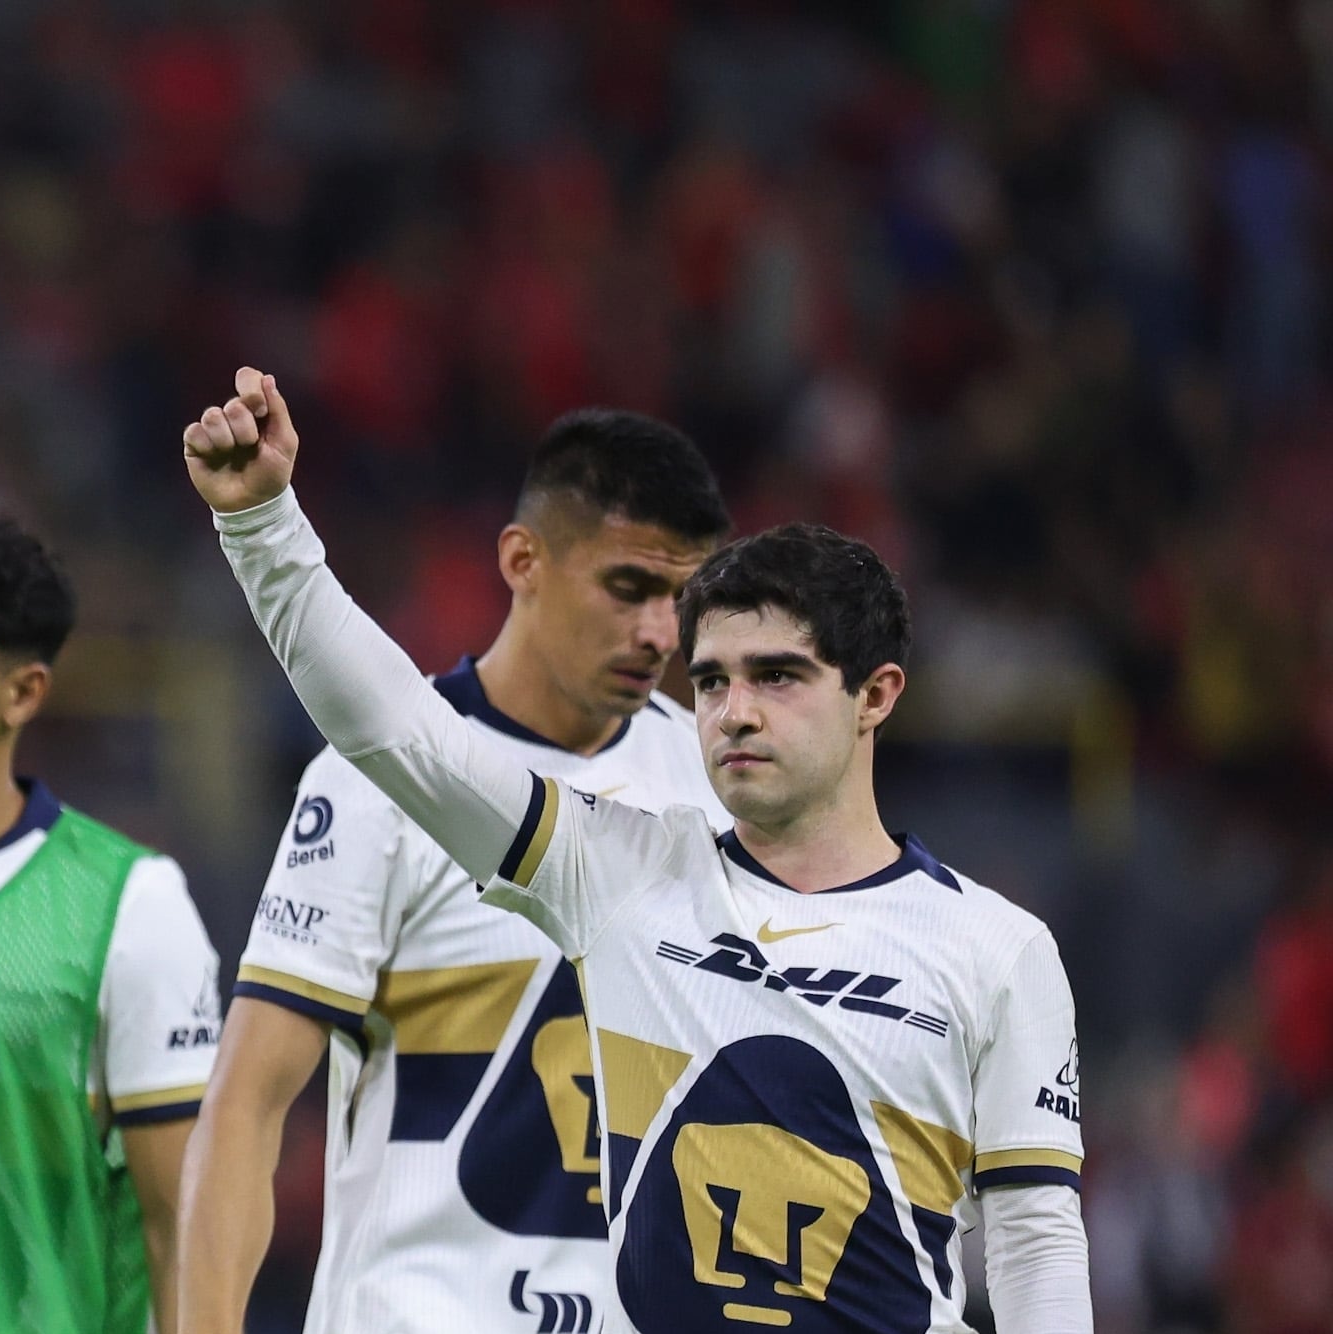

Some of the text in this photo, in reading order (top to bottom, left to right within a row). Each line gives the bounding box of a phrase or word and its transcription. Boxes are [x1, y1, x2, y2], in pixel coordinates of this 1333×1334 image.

[287, 840, 335, 868] Berel
[265, 895, 324, 930] GNP
[694, 932, 913, 1022] DHL
